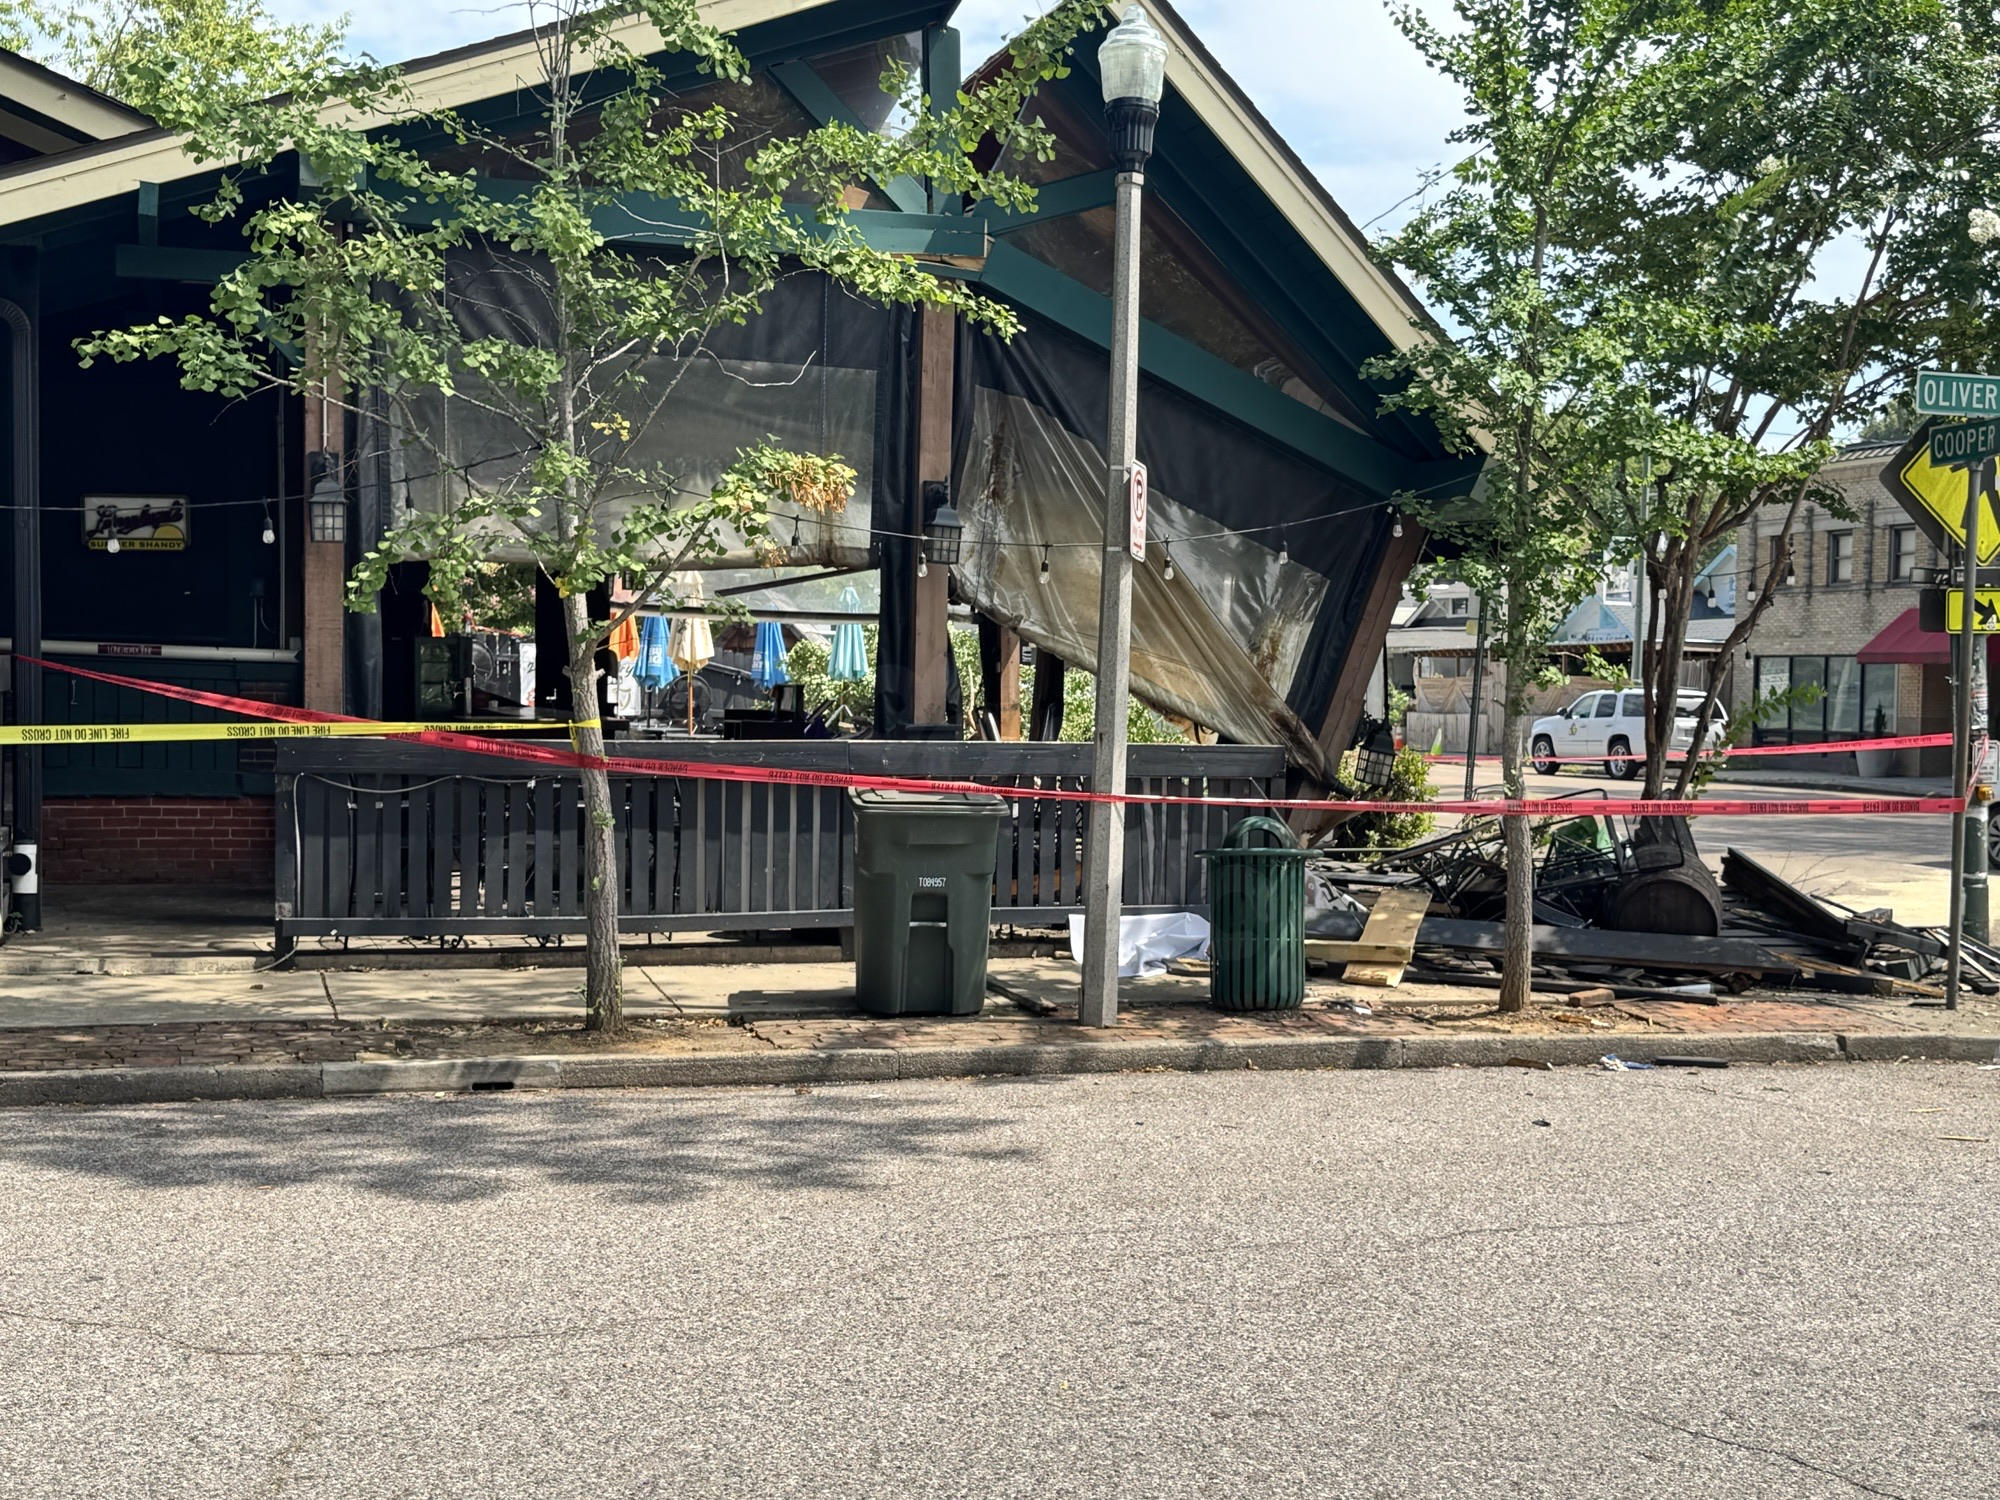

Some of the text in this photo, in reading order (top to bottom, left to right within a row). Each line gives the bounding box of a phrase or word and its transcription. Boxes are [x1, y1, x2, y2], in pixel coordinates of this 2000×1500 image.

[1923, 379, 1998, 410] OLIVER
[1934, 425, 1996, 459] COOPER
[22, 728, 130, 741] FIRE LINE DO NOT CROSS
[227, 726, 330, 736] FIRE LINE DO NOT CROSS
[1528, 803, 1539, 813] NOT
[1541, 803, 1549, 813] DO
[1551, 803, 1572, 813] DANGER
[1631, 803, 1693, 814] DANGER DO NOT ENTER
[1749, 803, 1809, 813] DANGER DO NOT ENTER
[1863, 801, 1920, 813] DANGER DO NOT ENTER
